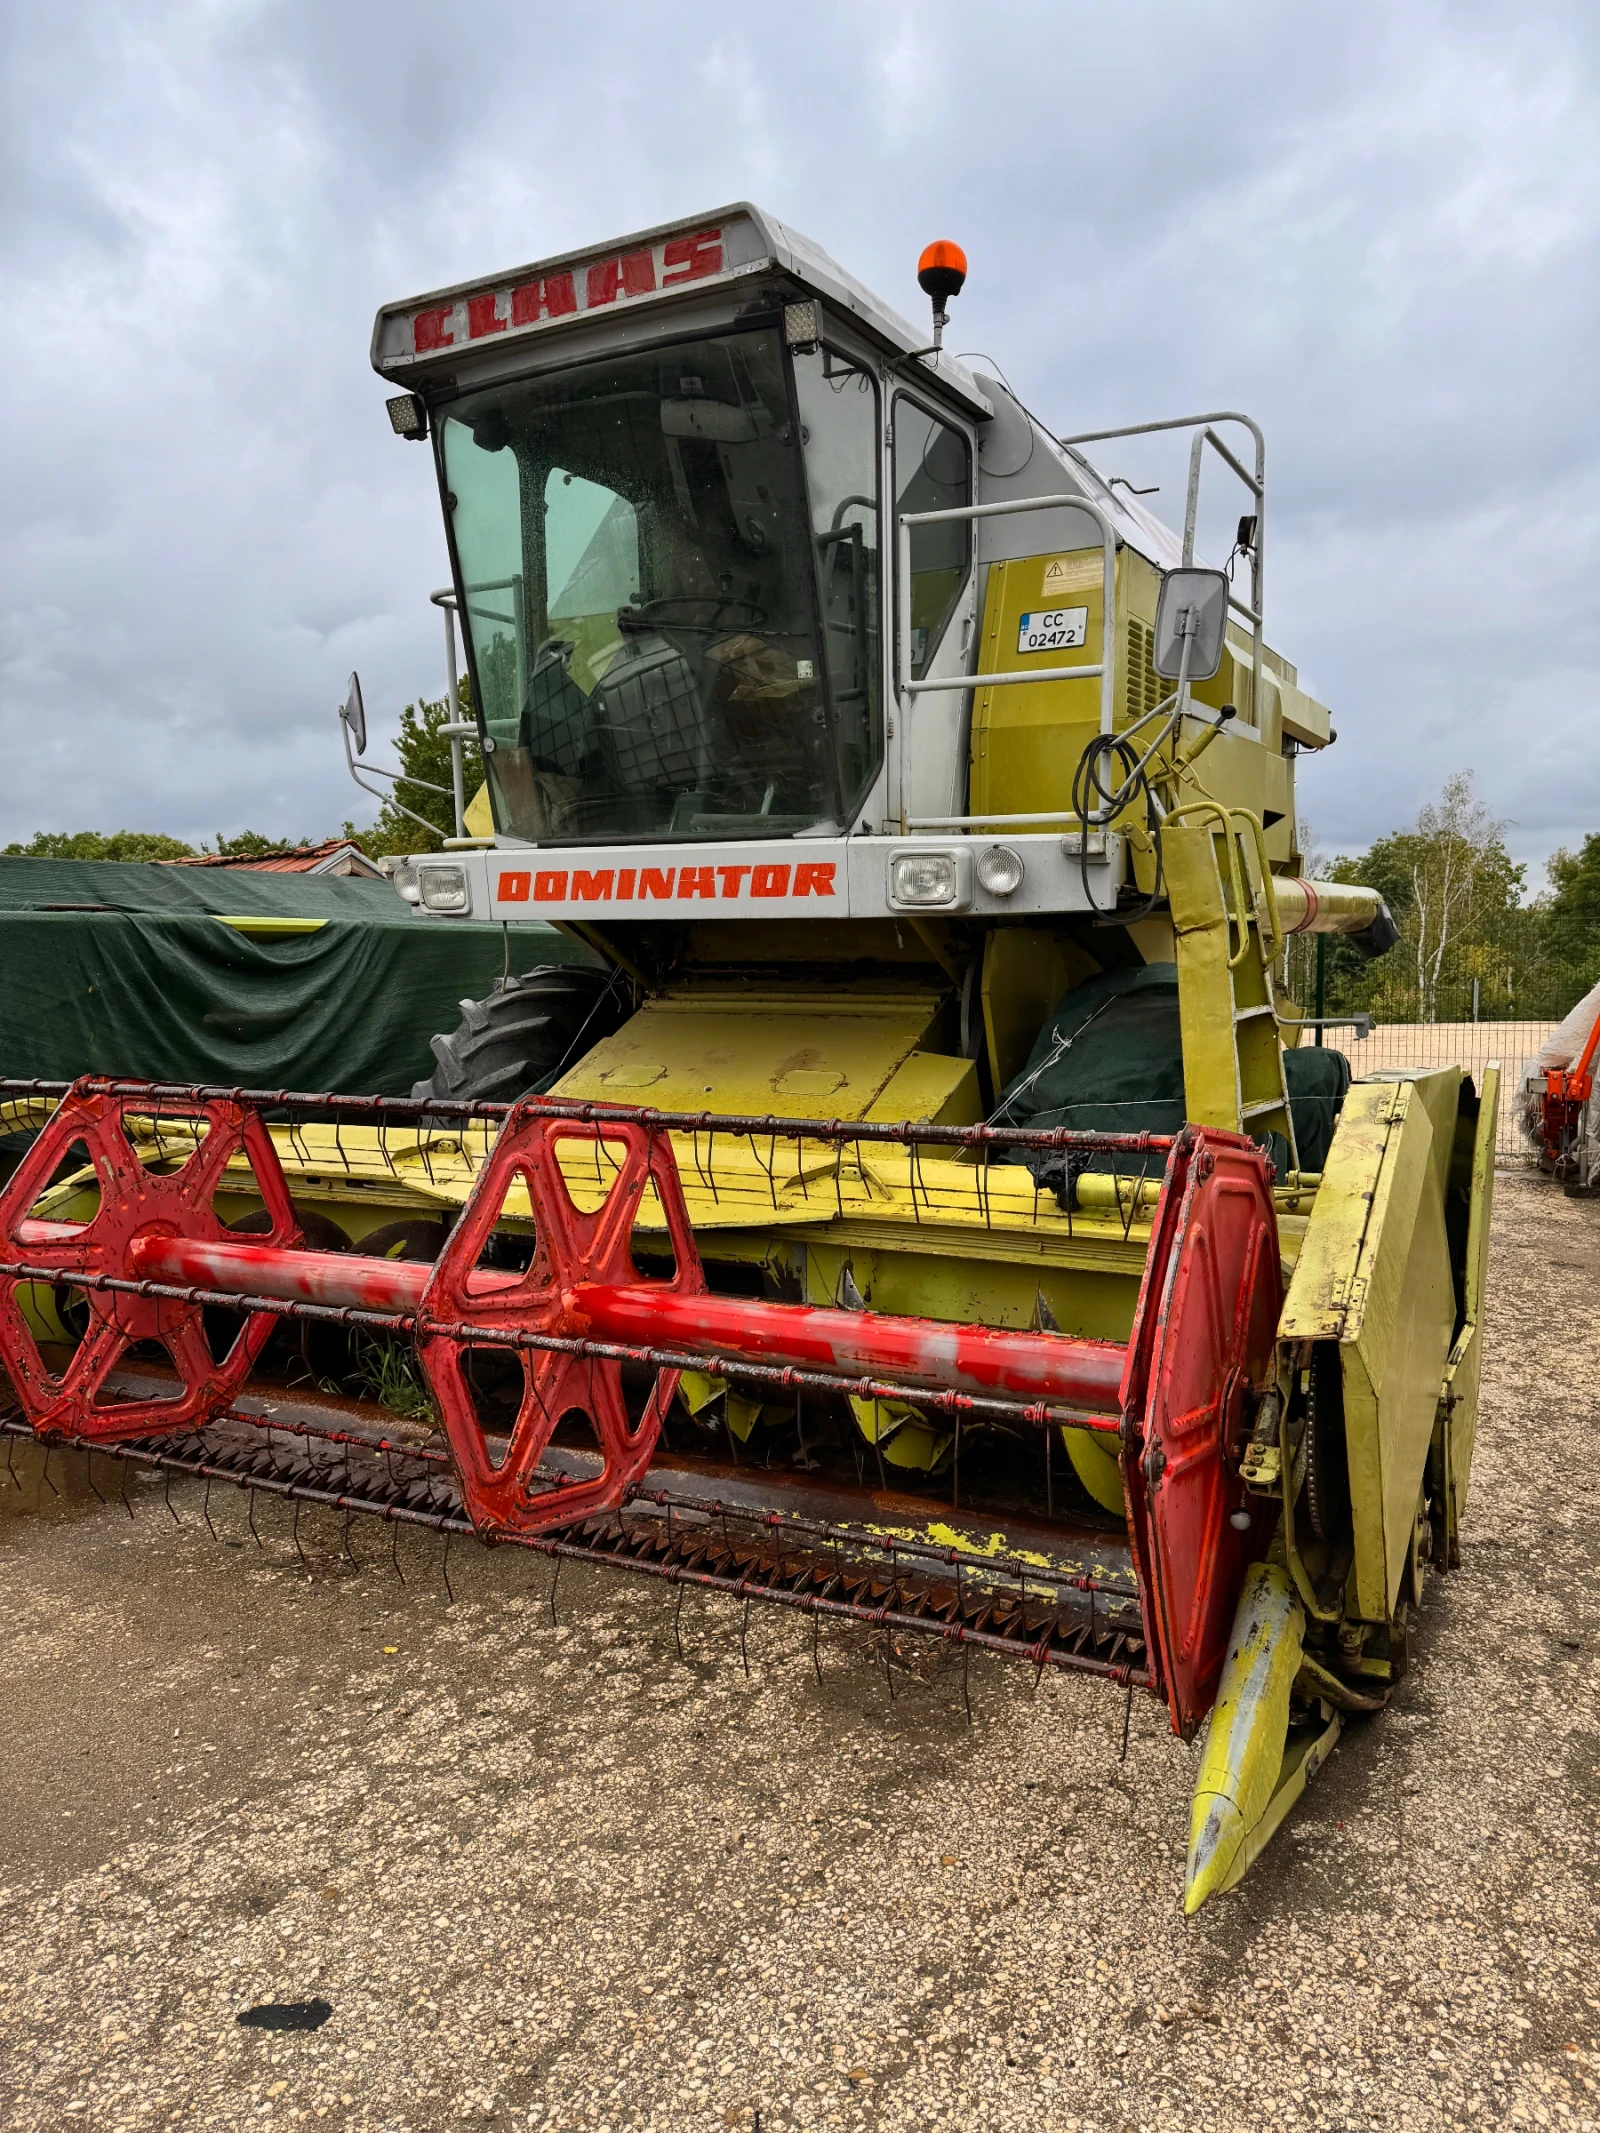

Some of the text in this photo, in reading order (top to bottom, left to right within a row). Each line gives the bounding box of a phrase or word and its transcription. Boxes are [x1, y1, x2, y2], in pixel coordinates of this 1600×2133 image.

[413, 229, 723, 353] CLAAS
[1043, 613, 1064, 628] CC
[1028, 630, 1075, 647] 02472
[496, 861, 837, 903] DOMINATOR
